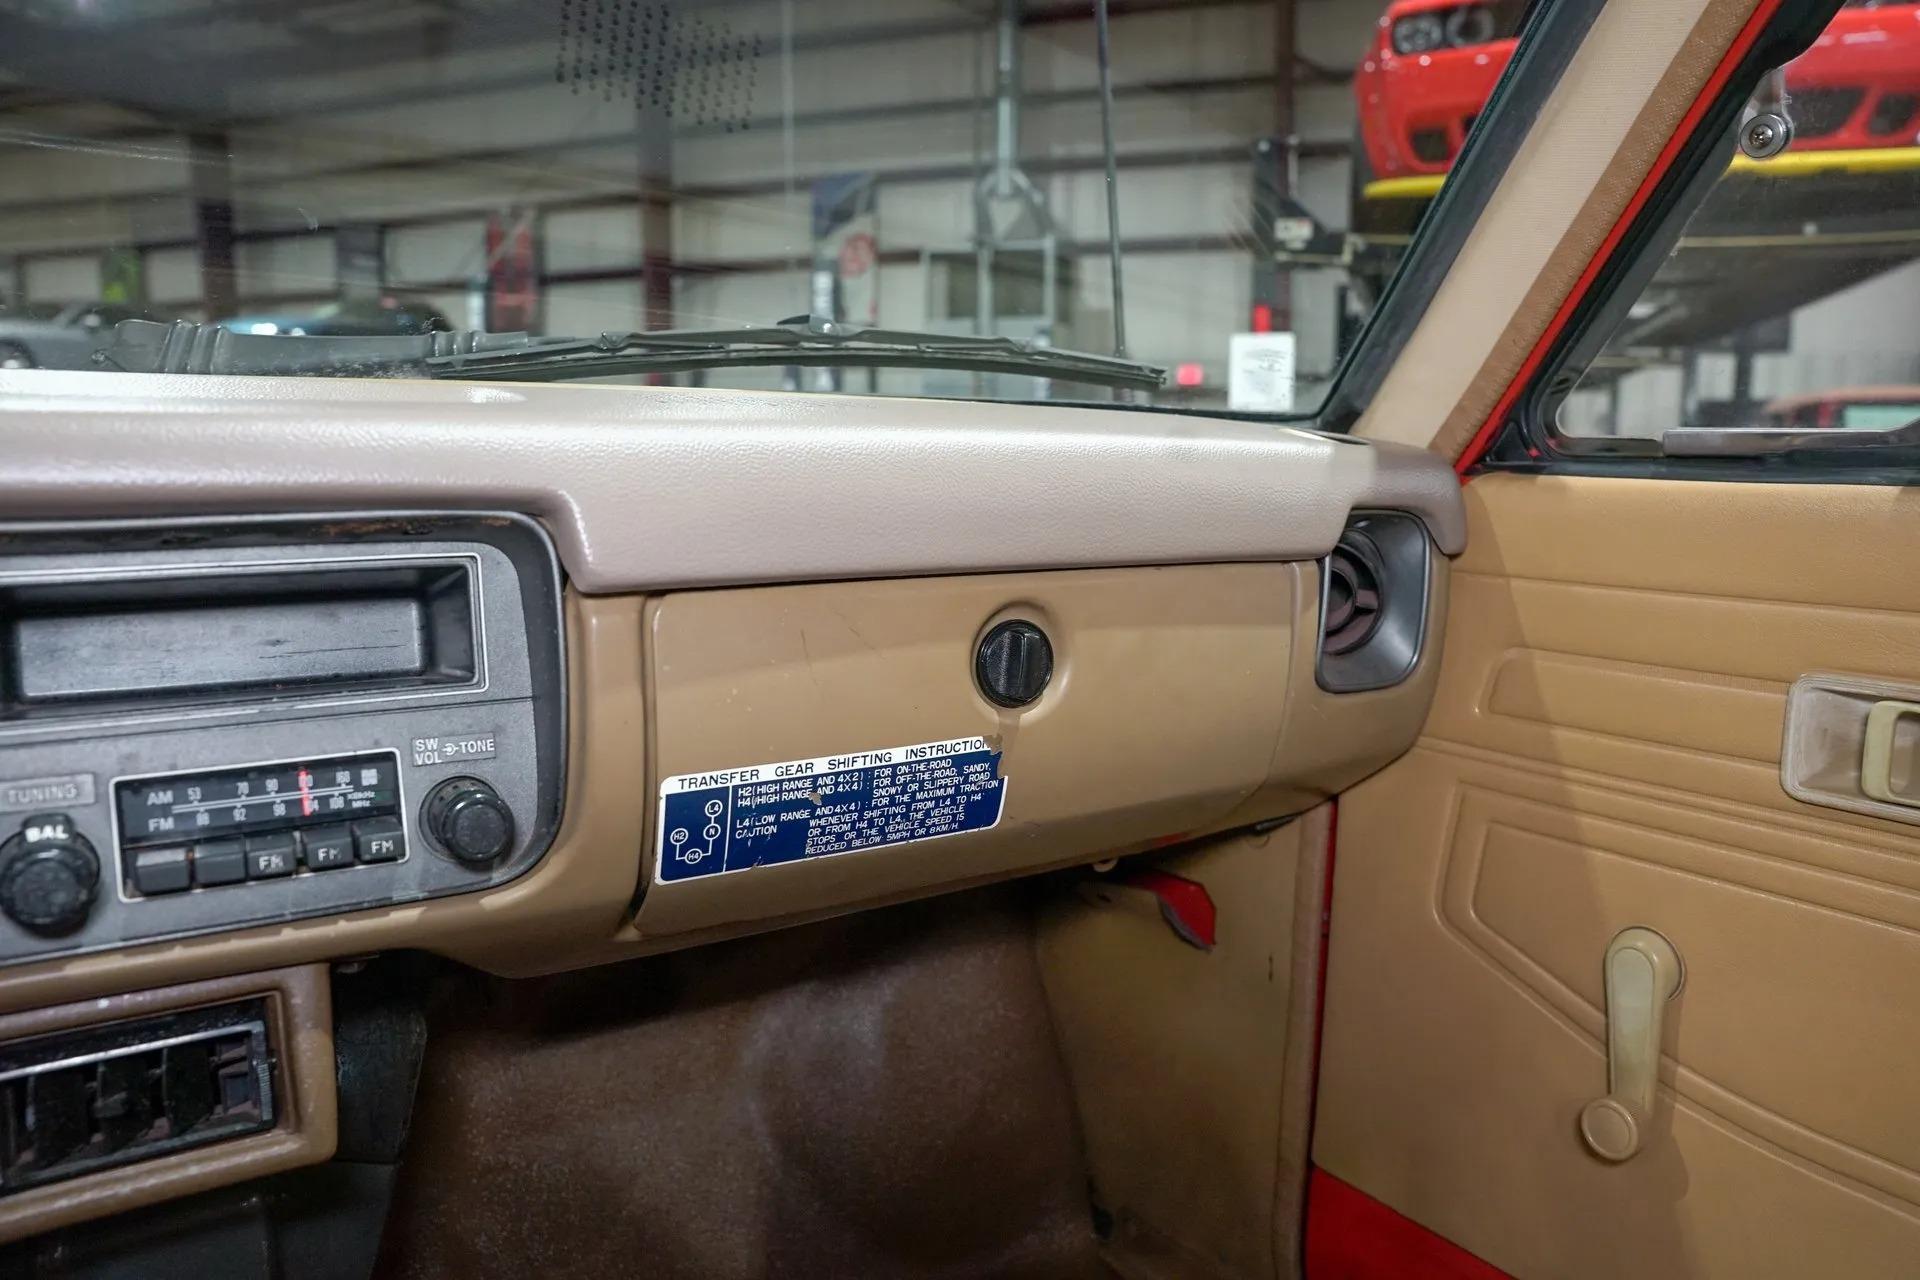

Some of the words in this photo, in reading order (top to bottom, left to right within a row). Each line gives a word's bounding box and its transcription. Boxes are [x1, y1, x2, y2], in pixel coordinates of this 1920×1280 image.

[415, 738, 438, 751] SW
[459, 739, 494, 753] TONE
[415, 752, 442, 765] VOL
[678, 769, 760, 790] TRANSFER
[775, 762, 814, 777] GEAR
[828, 752, 892, 770] SHIFTING
[782, 778, 813, 790] RANGE
[817, 775, 835, 786] AND
[875, 768, 892, 778] FOR
[897, 759, 952, 774] ON-THE-ROAD
[9, 783, 77, 802] TUNING
[782, 789, 812, 800] RANGE
[817, 786, 834, 796] AND
[873, 778, 890, 788] FOR
[873, 786, 905, 798] SNOWY
[908, 784, 919, 792] OR
[924, 777, 964, 789] SLIPPERY
[969, 772, 990, 782] ROAD
[147, 790, 173, 805] AM
[781, 810, 810, 822] RANGE
[815, 806, 833, 817] AND
[872, 797, 890, 807] FOR
[895, 794, 911, 803] THE
[916, 787, 955, 800] MAXIMUM
[960, 780, 999, 792] TRACTION
[709, 803, 719, 812] L4
[809, 813, 858, 827] WHENEVER
[864, 805, 906, 819] SHIFTING
[911, 801, 935, 811] FROM
[940, 797, 950, 806] L4
[957, 795, 967, 804] TO
[970, 793, 982, 801] H4
[148, 817, 174, 832] FM
[808, 827, 820, 836] OR
[826, 823, 850, 834] FROM
[856, 820, 868, 829] H4
[874, 816, 884, 825] TO
[910, 811, 924, 820] THE
[931, 805, 965, 817] VEHICLE
[25, 825, 69, 842] BAL
[674, 832, 685, 840] H2
[736, 825, 777, 839] CAUTION
[807, 835, 835, 846] STOPS
[844, 832, 856, 840] OR
[863, 826, 879, 836] THE
[885, 820, 920, 833] VEHICLE
[925, 816, 952, 827] SPEED
[957, 813, 965, 821] IS
[371, 840, 394, 854] FM
[805, 841, 846, 854] REDUCED
[852, 836, 881, 847] BELOW
[887, 832, 910, 841] 5MPH
[915, 828, 926, 836] OR
[259, 855, 283, 870] FM
[318, 848, 340, 861] FM
